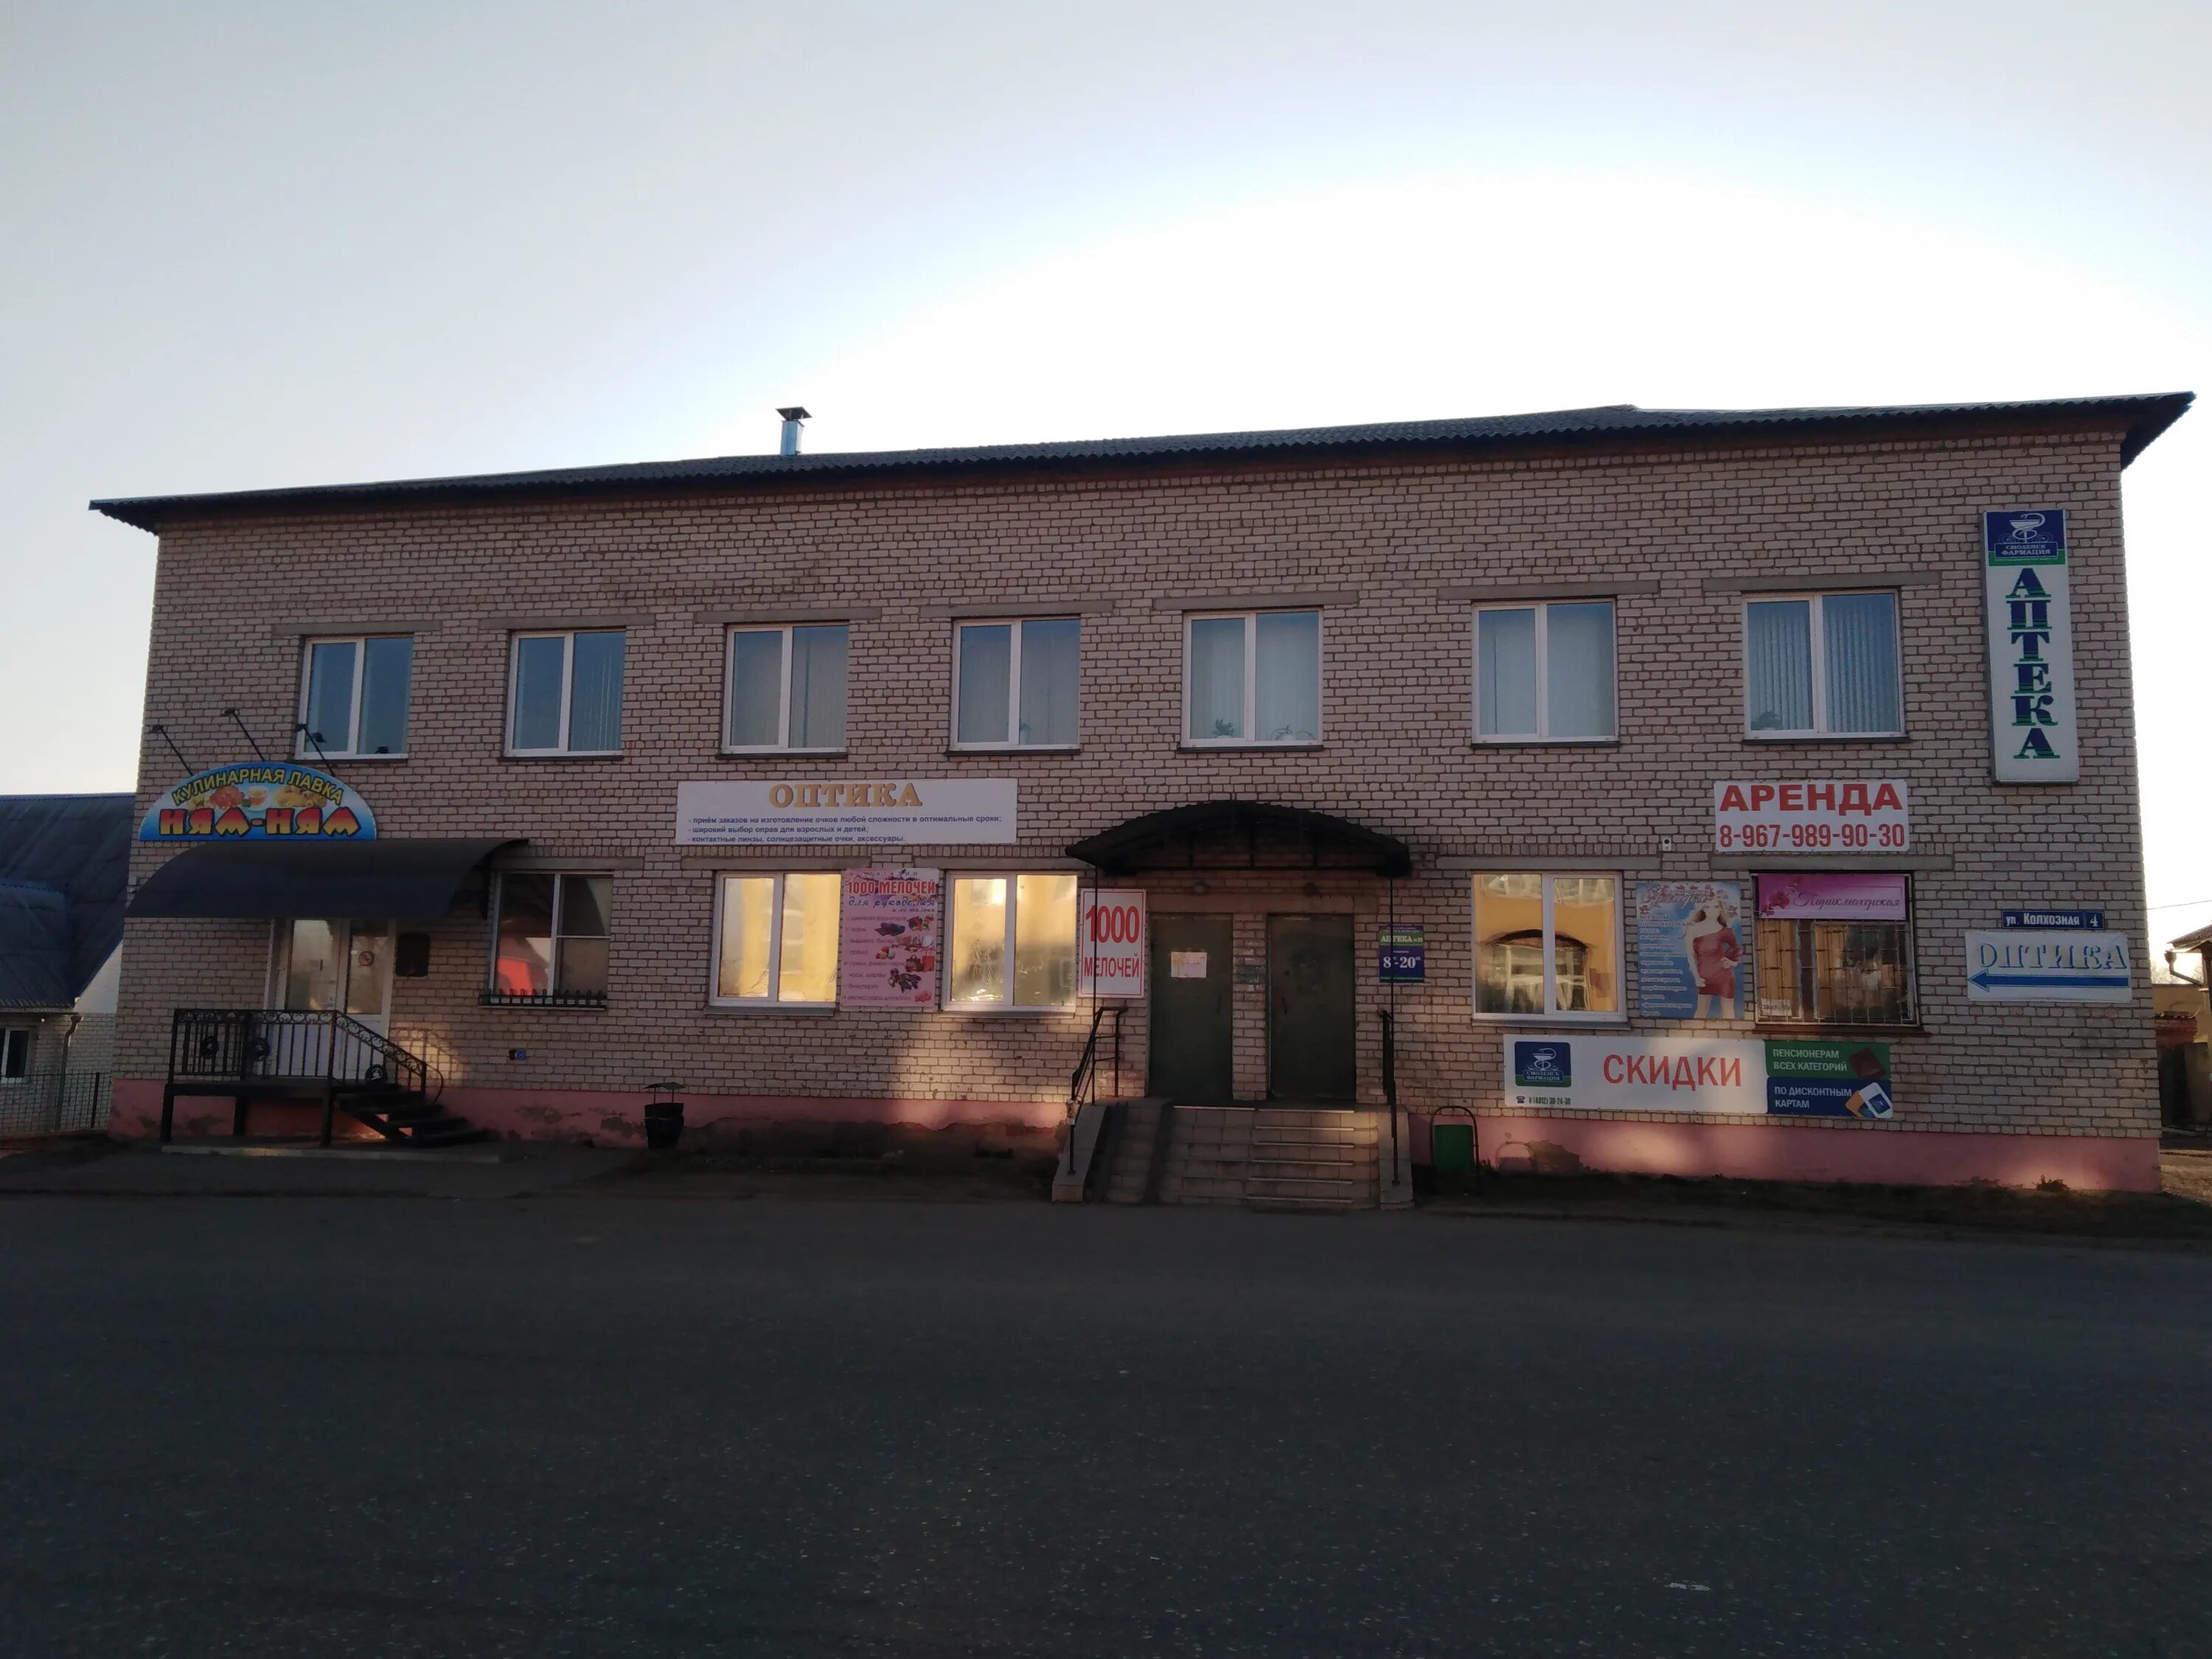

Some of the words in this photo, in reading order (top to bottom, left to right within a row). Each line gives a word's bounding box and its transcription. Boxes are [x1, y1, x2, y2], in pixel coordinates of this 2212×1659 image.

[2005, 568, 2061, 759] АПТЕКА
[171, 768, 285, 806] КУЛИНАРНАЯ
[288, 772, 345, 806] ЛАВКА
[769, 782, 923, 808] ОПТИКА
[1719, 783, 1903, 816] АРЕНДА
[158, 806, 362, 837] НЯМ-НЯМ
[692, 826, 726, 834] широкий
[728, 825, 753, 834] выбор
[797, 826, 835, 834] взрослых
[840, 815, 866, 824] любой
[919, 815, 974, 824] оптимальные
[766, 835, 833, 843] солнцезащитные
[1719, 824, 1905, 847] 8-967-989-90-30
[849, 880, 874, 894] 1000
[879, 879, 936, 894] МЕЛОЧЕЙ
[848, 896, 869, 907] для
[1793, 891, 1901, 911] Парикмахерская
[1085, 905, 1140, 944] 1000
[2090, 914, 2098, 927] 4
[1084, 953, 1139, 978] МЕЛОЧЕЙ
[1978, 943, 2127, 969] ОПТИКА
[1773, 1048, 1840, 1059] ПЕНСИОНЕРАМ
[1603, 1054, 1742, 1092] СКИДКИ
[1773, 1061, 1797, 1070] ВСЕХ
[1798, 1061, 1848, 1071] КАТЕГОРИЙ
[1774, 1086, 1787, 1095] ПО
[1789, 1087, 1852, 1097] ДИСКОНТНЫМ
[1775, 1099, 1810, 1108] КАРТАМ
